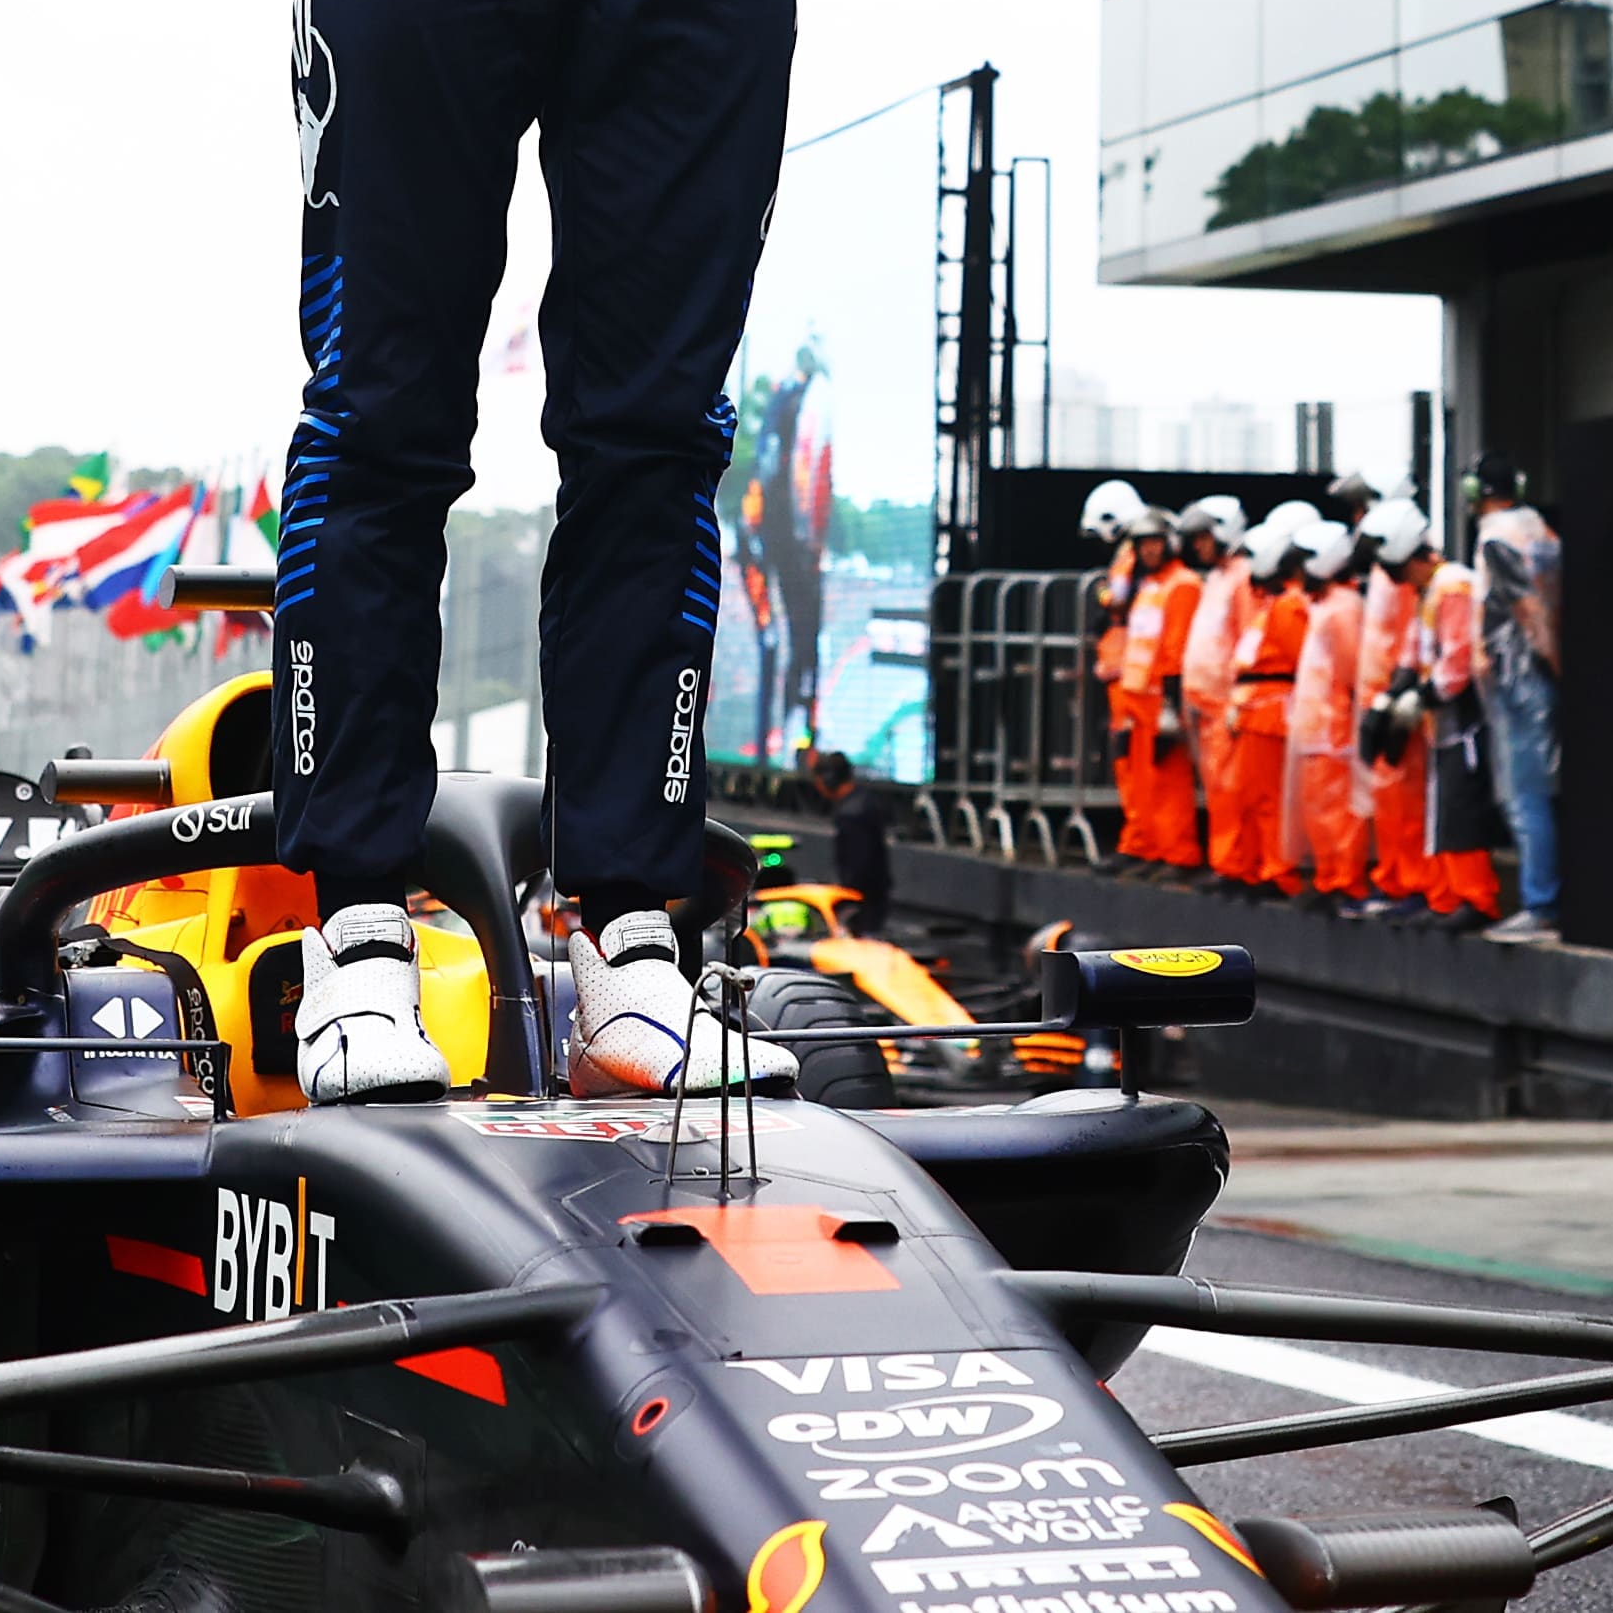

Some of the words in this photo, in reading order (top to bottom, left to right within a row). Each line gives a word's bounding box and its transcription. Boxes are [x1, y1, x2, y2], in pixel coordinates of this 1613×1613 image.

[290, 640, 315, 776] sparco
[664, 667, 701, 804] sparco
[207, 800, 255, 834] Sui
[187, 988, 216, 1095] spaco
[213, 1176, 336, 1322] BYBIT
[724, 1351, 1035, 1396] VISA
[767, 1405, 993, 1444] CDW
[805, 1457, 1126, 1501] zoom
[956, 1494, 1151, 1526] ARCTIC
[989, 1516, 1147, 1547] WOLF
[869, 1545, 1203, 1595] PIRELLI
